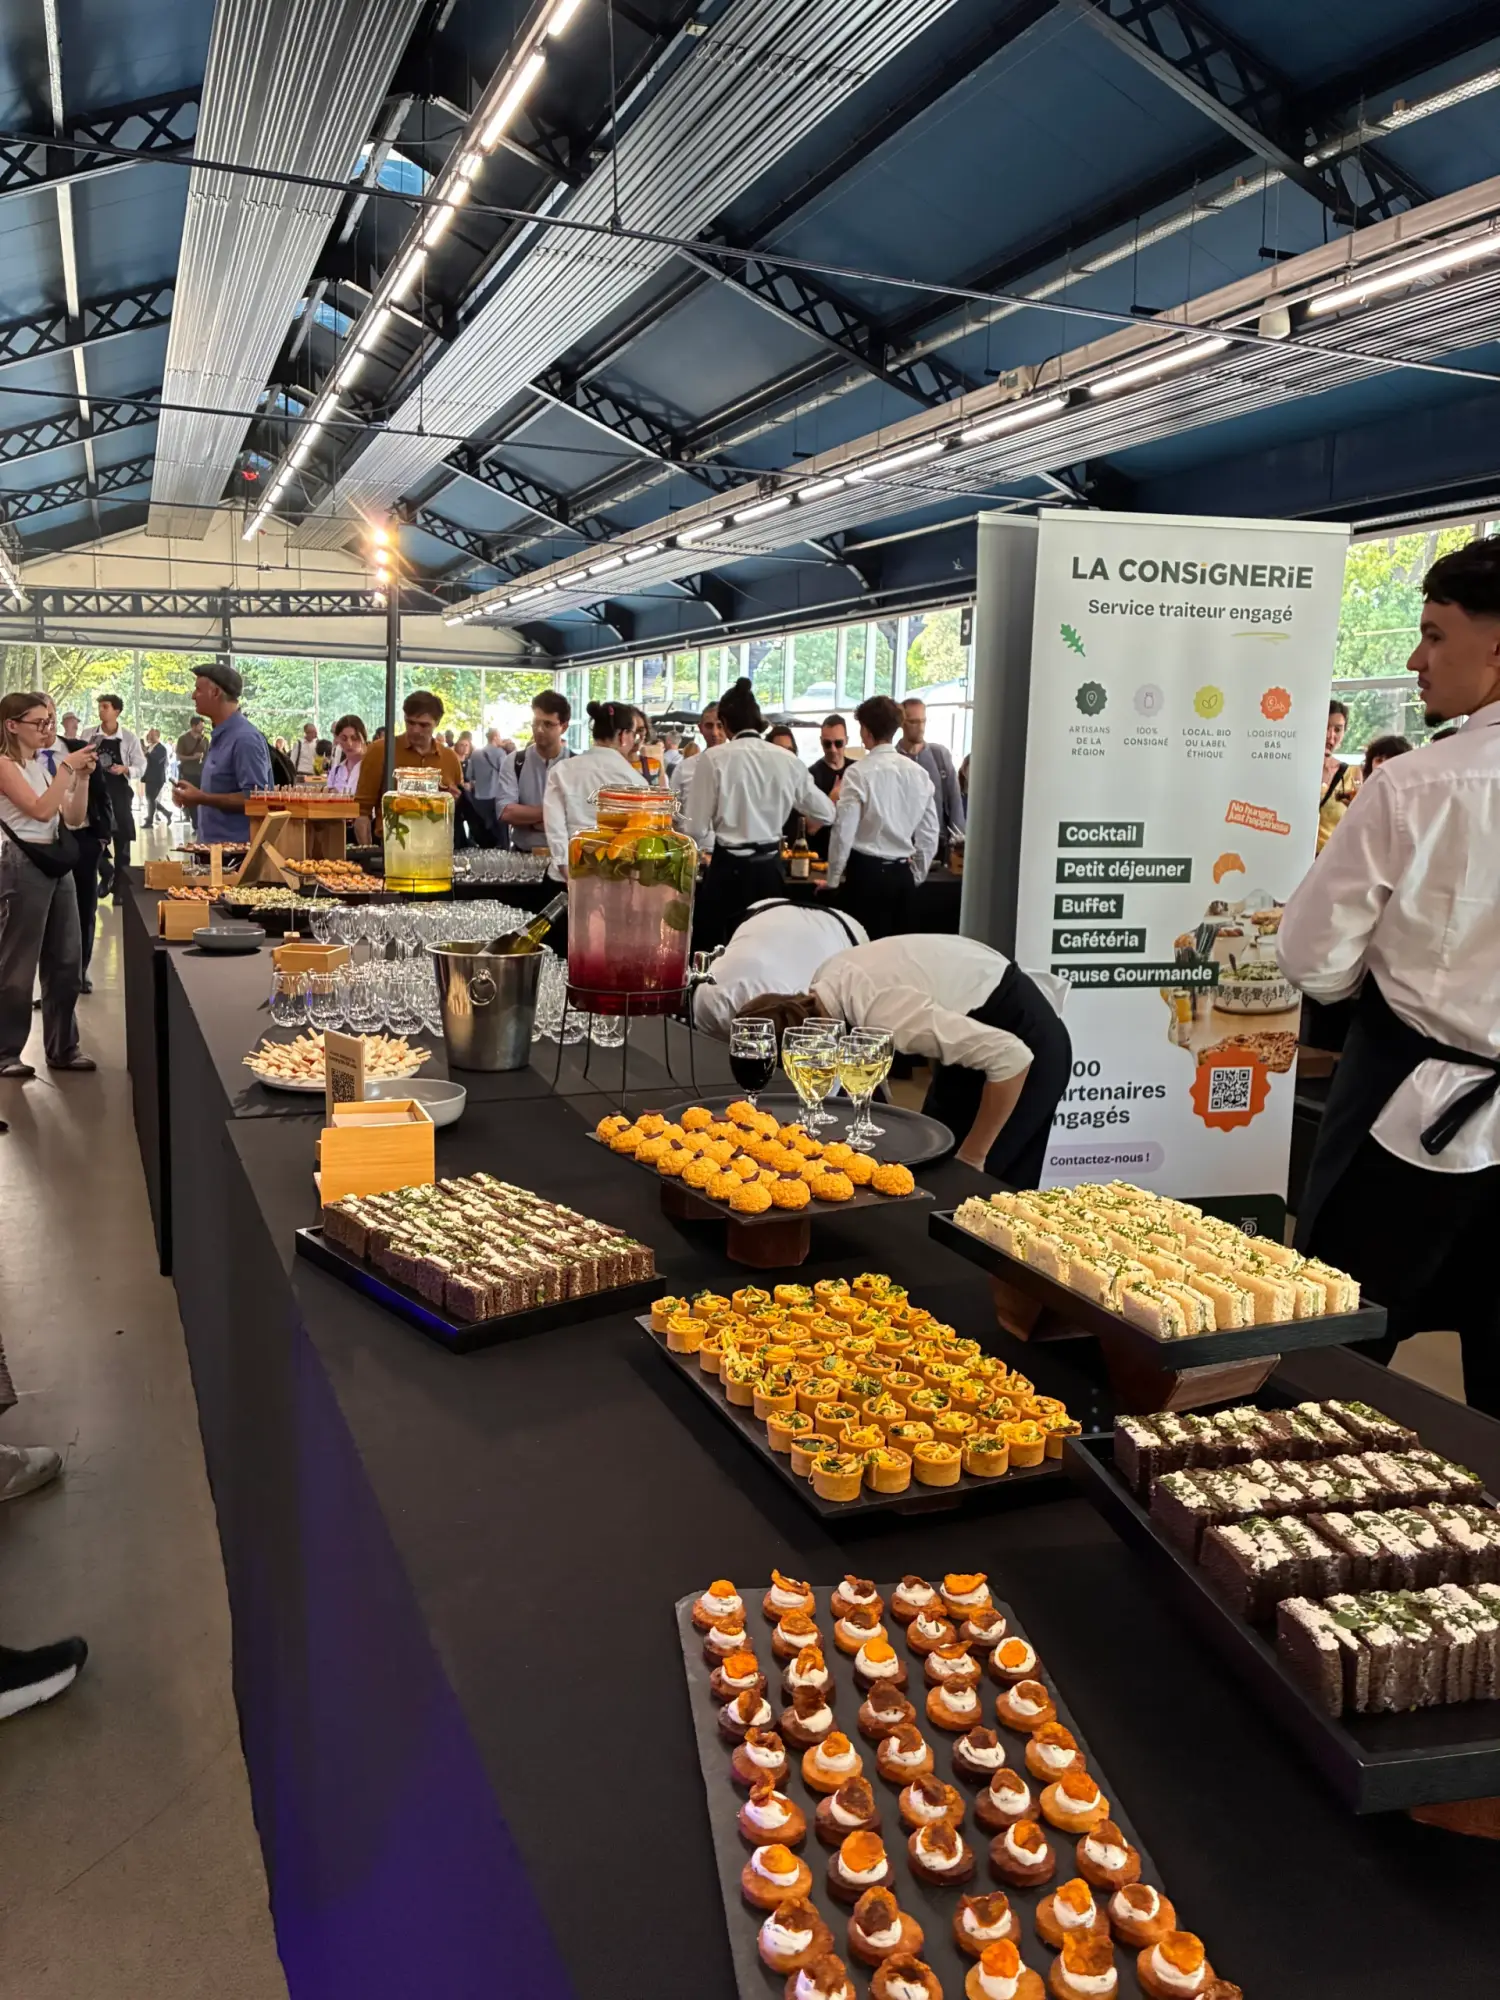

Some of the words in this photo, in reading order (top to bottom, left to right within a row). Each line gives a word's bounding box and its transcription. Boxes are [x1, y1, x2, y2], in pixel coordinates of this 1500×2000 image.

[1071, 556, 1109, 580] LA
[1088, 599, 1154, 615] Service
[1159, 601, 1225, 618] traiteur
[1229, 604, 1293, 623] engagé
[1069, 726, 1110, 734] ARTISANS
[1136, 726, 1158, 735] 100%
[1216, 728, 1231, 737] BIO
[1247, 730, 1297, 738] LOGISTIQUE
[1076, 737, 1088, 745] DE
[1090, 737, 1101, 745] LA
[1123, 736, 1168, 746] CONSIGNÉ
[1185, 739, 1198, 747] OU
[1200, 739, 1226, 748] LABEL
[1264, 741, 1281, 749] BAS
[1071, 747, 1105, 756] RÉGION
[1187, 749, 1223, 758] ÉTHIQUE
[1251, 752, 1292, 760] CARBONE
[1066, 825, 1137, 842] Cocktail
[1063, 860, 1104, 877] Petit
[1108, 860, 1185, 881] déjeuner
[1061, 897, 1117, 913] Buffet
[1059, 930, 1139, 948] Cafétéria
[1058, 968, 1109, 983] Pause
[1113, 965, 1212, 982] Gourmande
[1072, 1060, 1101, 1078] 00
[1052, 1105, 1130, 1129] ngagés
[1050, 1154, 1144, 1166] Contactez-nous
[1146, 1152, 1150, 1163] !
